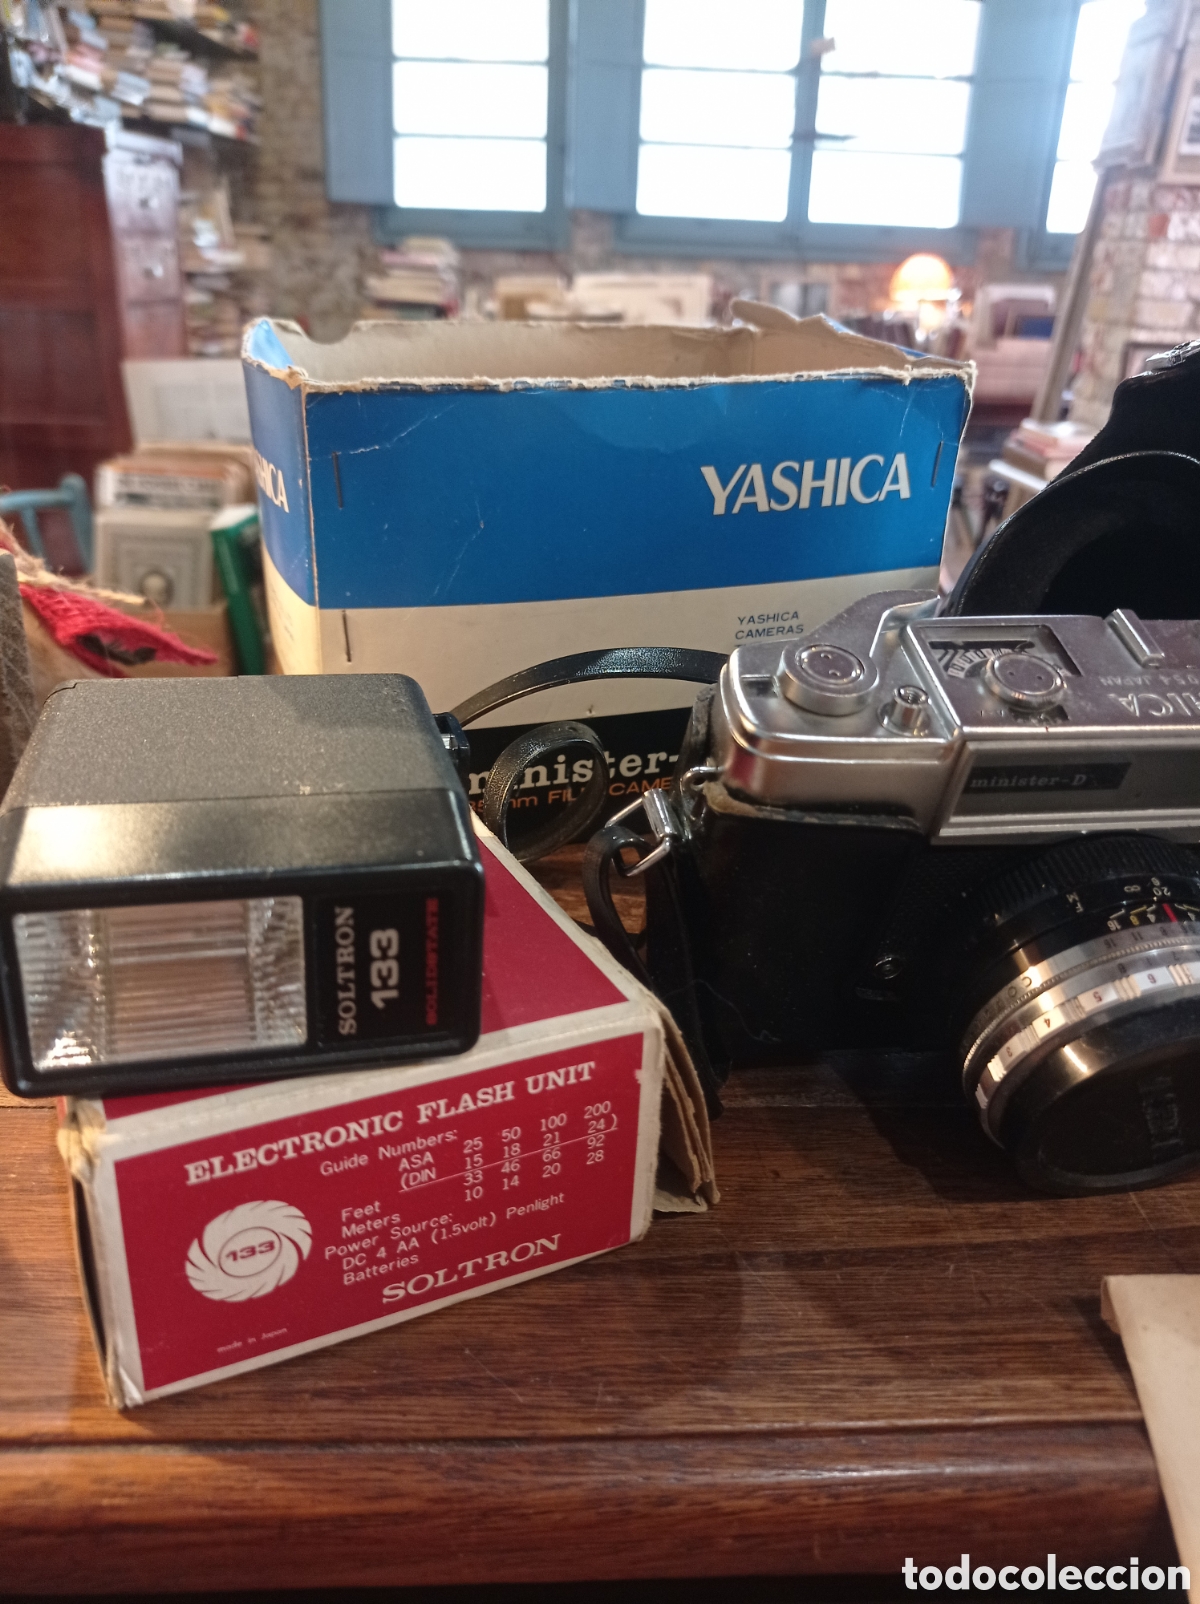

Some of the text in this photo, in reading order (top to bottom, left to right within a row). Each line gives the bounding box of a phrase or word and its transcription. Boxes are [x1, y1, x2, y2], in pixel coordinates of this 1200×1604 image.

[700, 452, 911, 516] YASHICA
[735, 624, 804, 640] CAMERAS
[737, 611, 799, 625] YASHICA
[548, 788, 585, 804] FIL
[969, 773, 1088, 788] minister-D
[334, 906, 357, 1035] SOLTRON
[369, 928, 399, 1009] 133
[184, 1061, 596, 1186] ELECTRONIC FLASH UNIT
[319, 1129, 458, 1176] Guide Numbers:
[398, 1101, 611, 1172] ASA 25 50 100 200
[341, 1134, 605, 1222] Feet 33 46 66 92
[400, 1167, 437, 1190] (DIN
[465, 1154, 483, 1170] 15
[503, 1143, 521, 1158] 18
[543, 1132, 560, 1147] 21
[341, 1150, 604, 1238] Meters 10 14 20 28
[225, 1239, 275, 1264] 133
[324, 1213, 453, 1259] Power Source:
[342, 1253, 367, 1270] DC
[376, 1247, 387, 1259] 4
[397, 1237, 419, 1253] AA
[505, 1193, 565, 1220] Penlight
[343, 1254, 419, 1285] Batteries
[382, 1234, 562, 1304] SOLTRON
[216, 1340, 243, 1353] made
[261, 1327, 288, 1340] Japan
